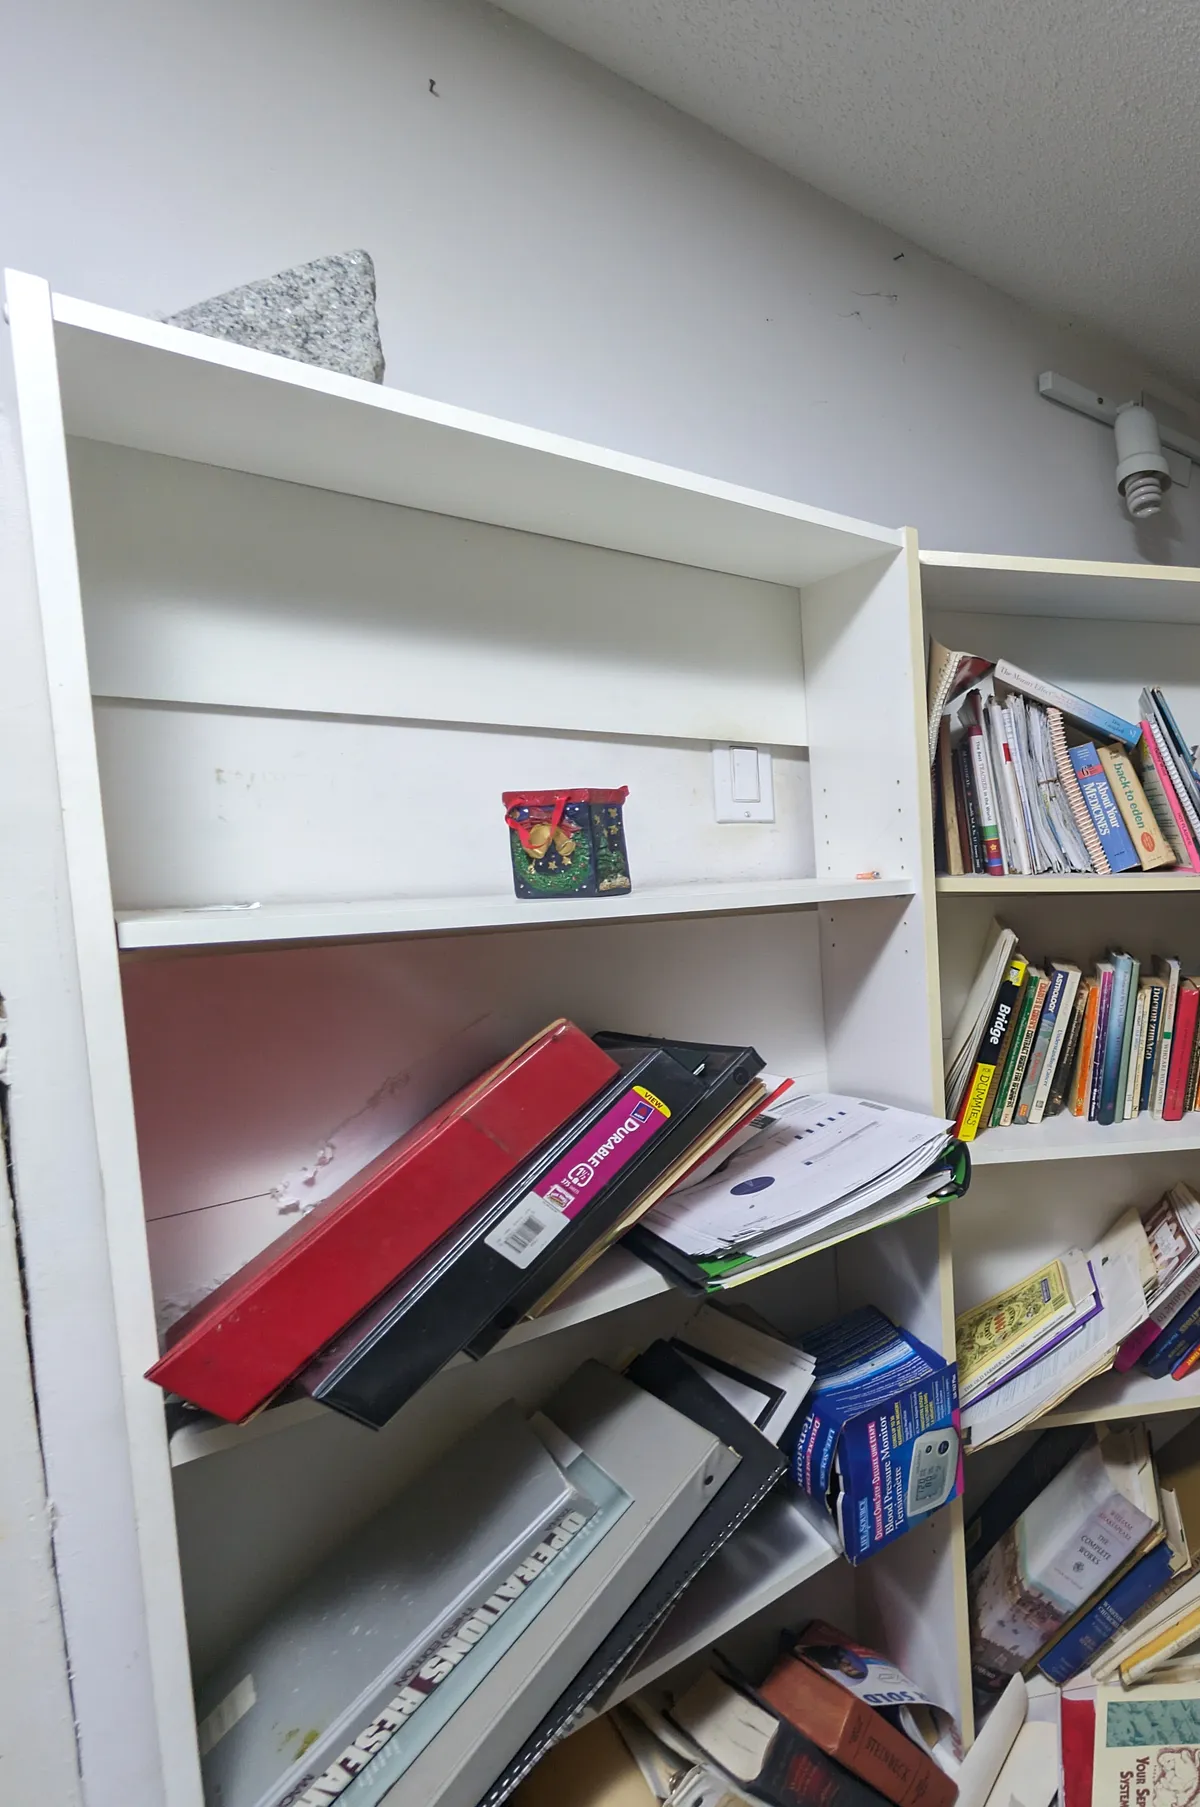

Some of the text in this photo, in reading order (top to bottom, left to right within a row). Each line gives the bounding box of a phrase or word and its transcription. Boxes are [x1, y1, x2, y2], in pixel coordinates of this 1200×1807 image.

[1112, 760, 1131, 790] back
[1082, 781, 1111, 837] MEDICINES
[1095, 779, 1115, 809] About
[1105, 806, 1122, 829] Your
[1123, 788, 1136, 802] to
[1128, 800, 1147, 830] eden
[1046, 972, 1065, 1013] ASTROLOGY
[985, 1002, 1013, 1046] Bridge
[1144, 986, 1160, 1059] DOCTOR ZHIVAGO
[1042, 1028, 1063, 1087] Understanding Cancer
[1161, 1043, 1169, 1059] WHO
[642, 1091, 663, 1110] VIEW
[964, 1072, 992, 1126] DUMMIES
[586, 1115, 640, 1170] DURABLE
[1161, 1286, 1188, 1314] Guide
[1154, 1309, 1168, 1323] to
[962, 1342, 1026, 1392] THE OLD FARMER'S ALMANAC
[806, 1419, 821, 1454] DELUXE
[869, 1455, 880, 1483] DELUXE
[876, 1415, 895, 1535] Blood Pressure Monitor
[870, 1484, 881, 1501] STEP
[872, 1500, 882, 1515] ONE
[892, 1465, 904, 1529] Tensiomètre
[872, 1515, 883, 1540] DELUXE
[1096, 1533, 1110, 1546] THE
[1077, 1545, 1101, 1566] WORKS
[1078, 1533, 1112, 1561] COMPLETE
[415, 1505, 593, 1690] OPERATIONS
[1099, 1600, 1126, 1623] WINSTON
[393, 1603, 476, 1689] THIRD EDITION
[863, 1690, 916, 1704] SOLD
[864, 1734, 914, 1784] STEINBECK
[1132, 1756, 1152, 1785] YOUR
